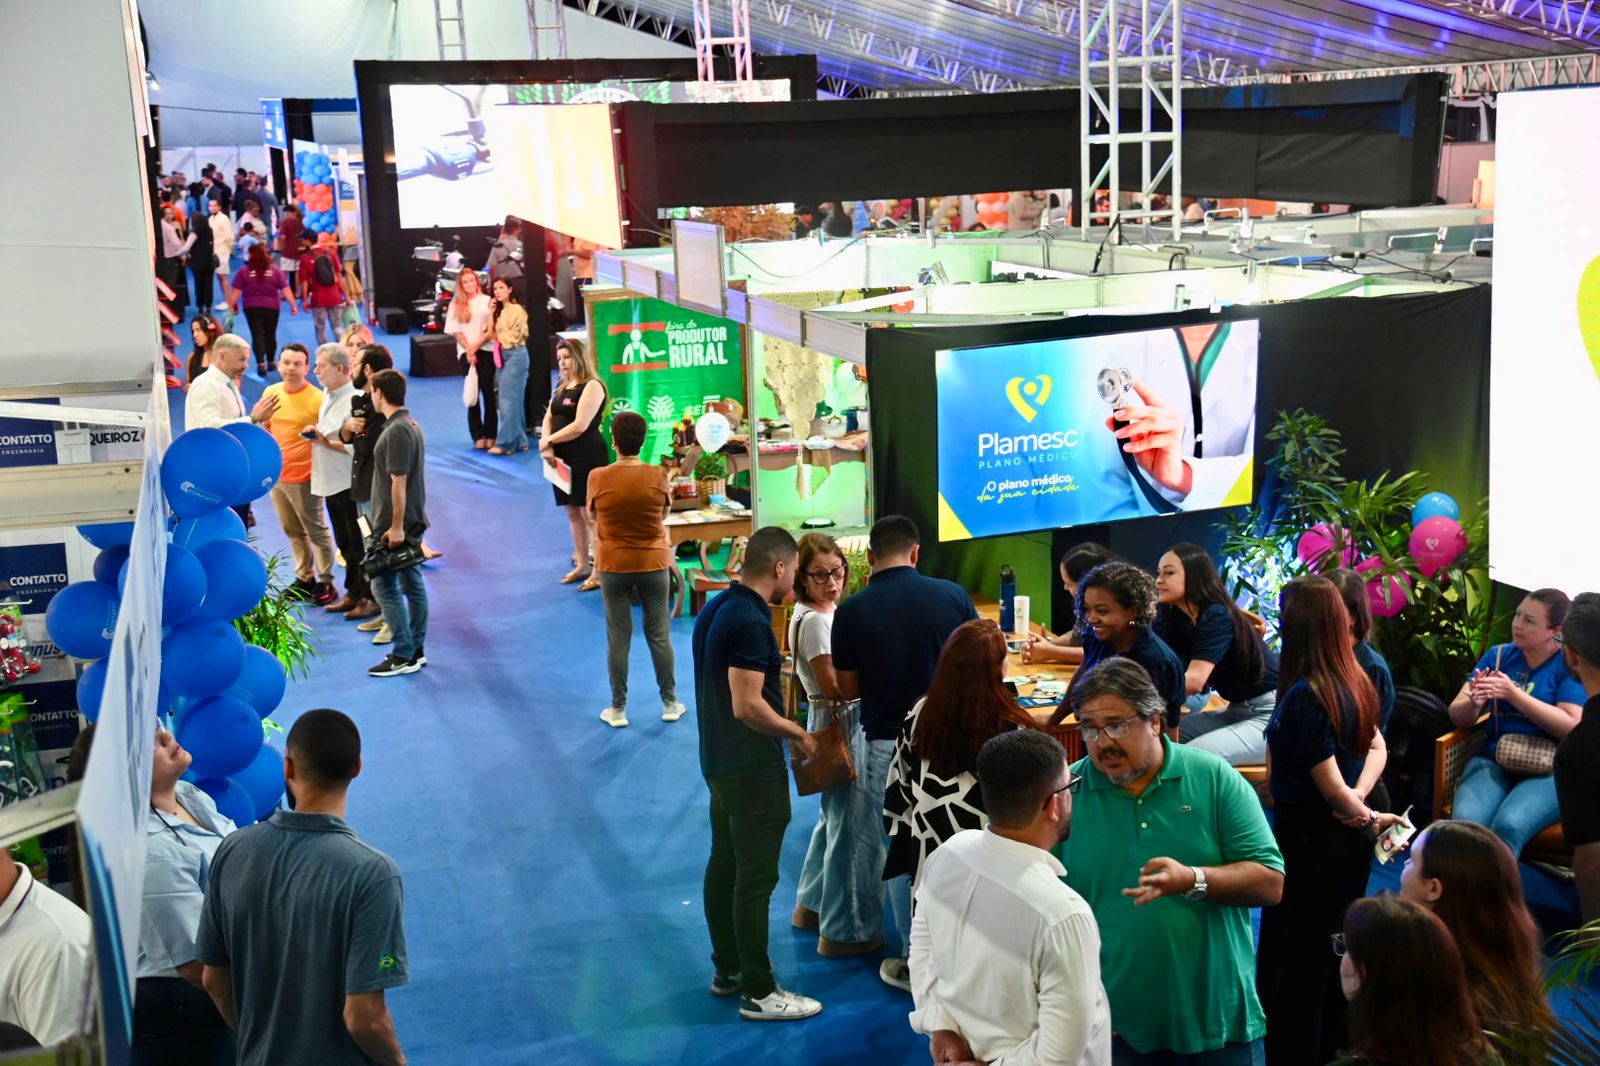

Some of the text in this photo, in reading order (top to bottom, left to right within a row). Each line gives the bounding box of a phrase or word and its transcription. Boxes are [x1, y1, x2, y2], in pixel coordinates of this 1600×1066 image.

[667, 327, 727, 345] PRODUTOR
[669, 342, 728, 369] RURAL
[89, 430, 141, 446] QUEIROZ
[978, 430, 1078, 457] Plamesc
[979, 451, 1078, 470] PLANO MÉDICO
[977, 476, 1079, 504] da sua cidade
[987, 474, 1071, 492] O plano médico
[10, 573, 66, 586] CONTATTO
[30, 710, 78, 722] ONTATTO
